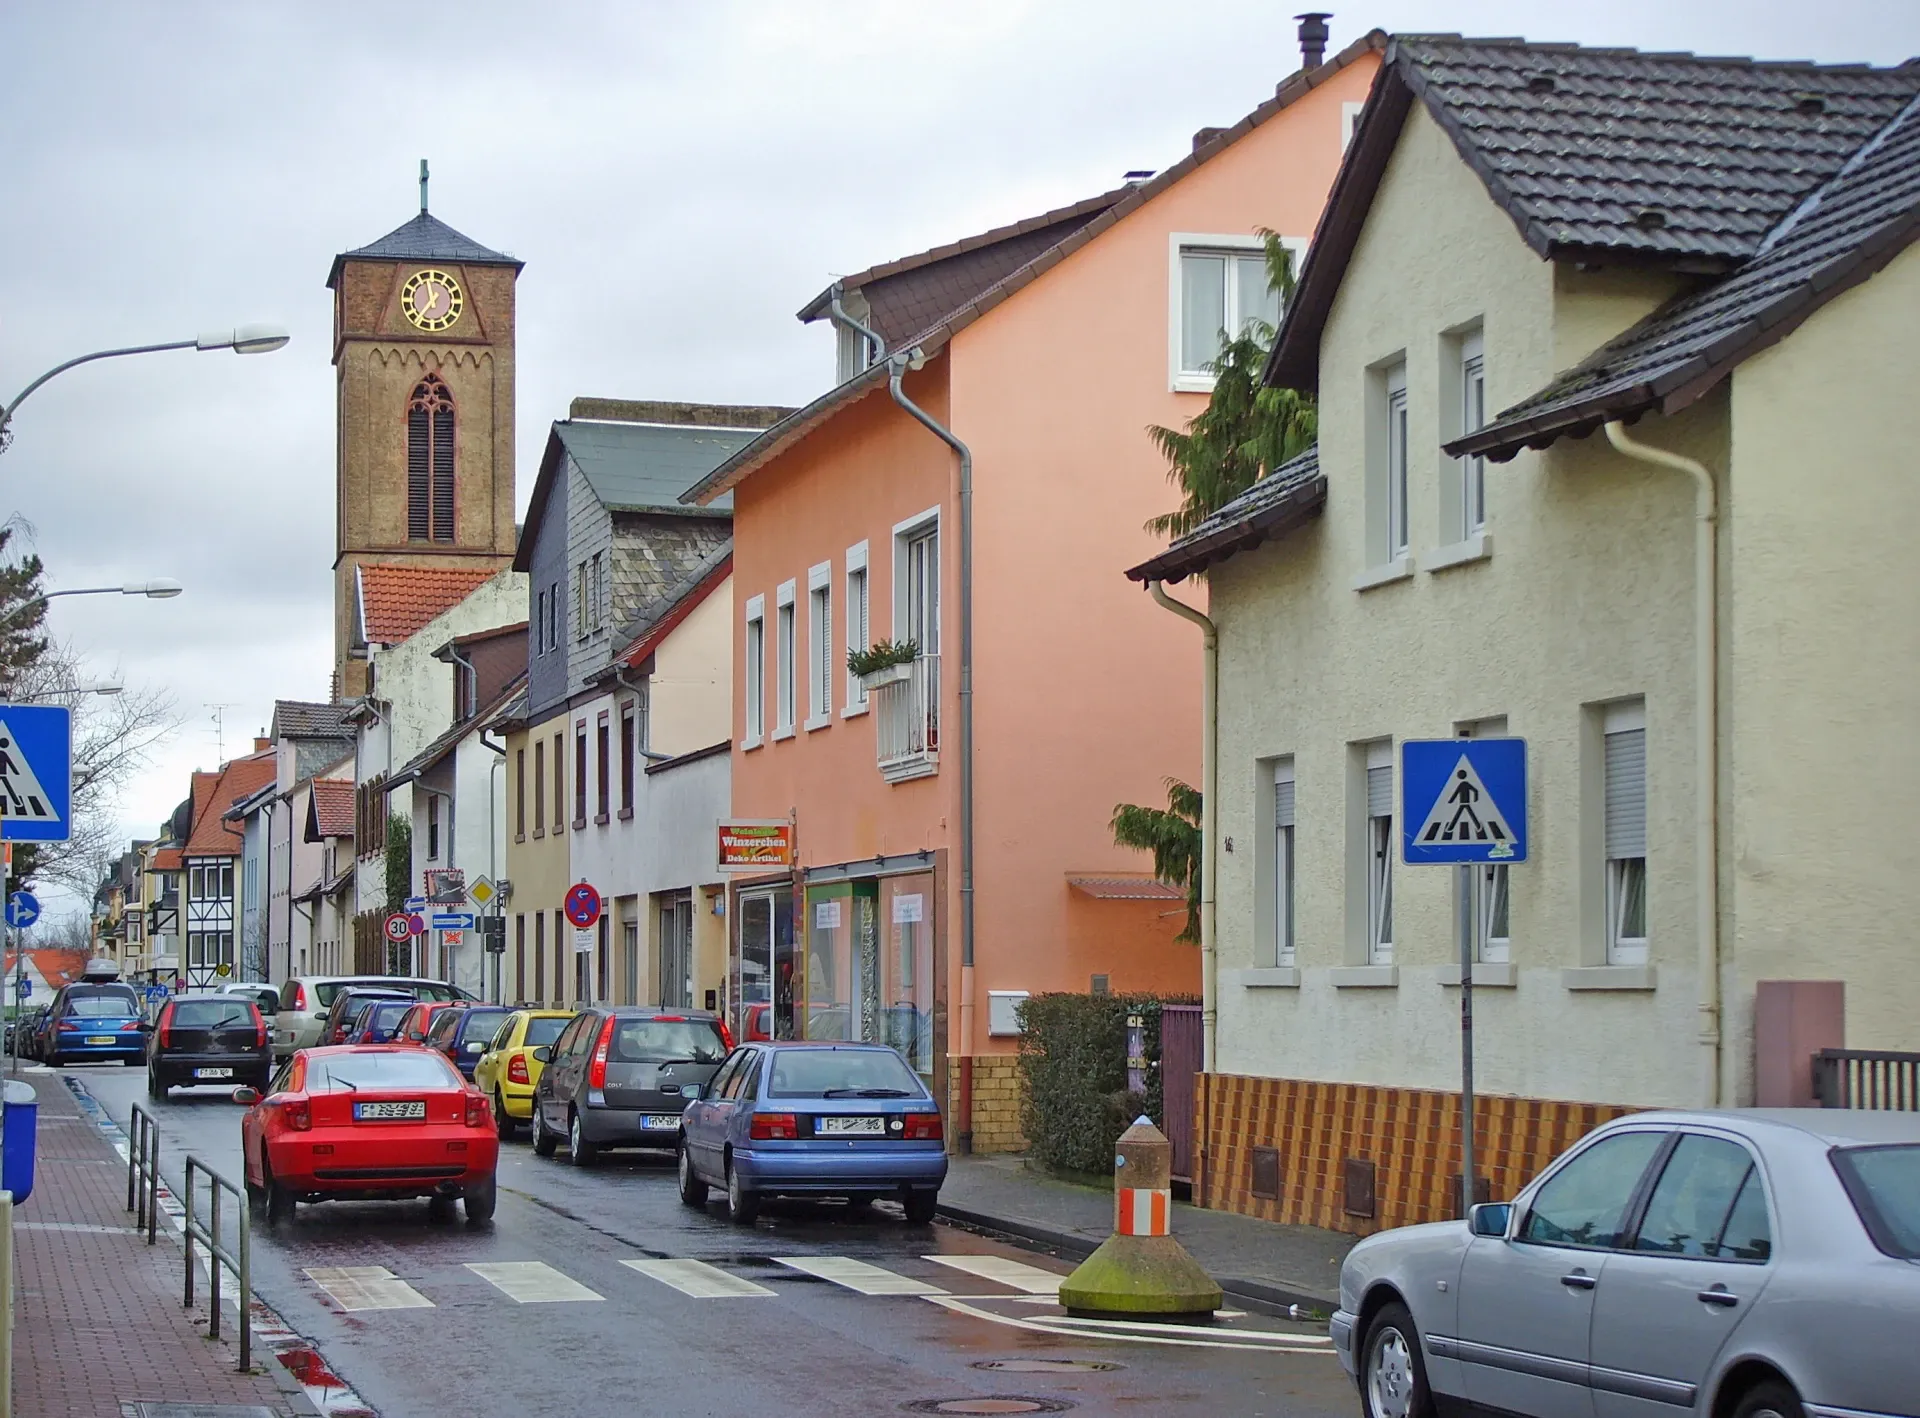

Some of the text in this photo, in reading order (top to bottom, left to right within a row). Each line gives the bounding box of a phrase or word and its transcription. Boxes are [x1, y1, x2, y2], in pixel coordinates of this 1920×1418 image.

[722, 836, 786, 847] Winzerchen
[751, 854, 782, 862] Artikel
[391, 922, 407, 934] 30
